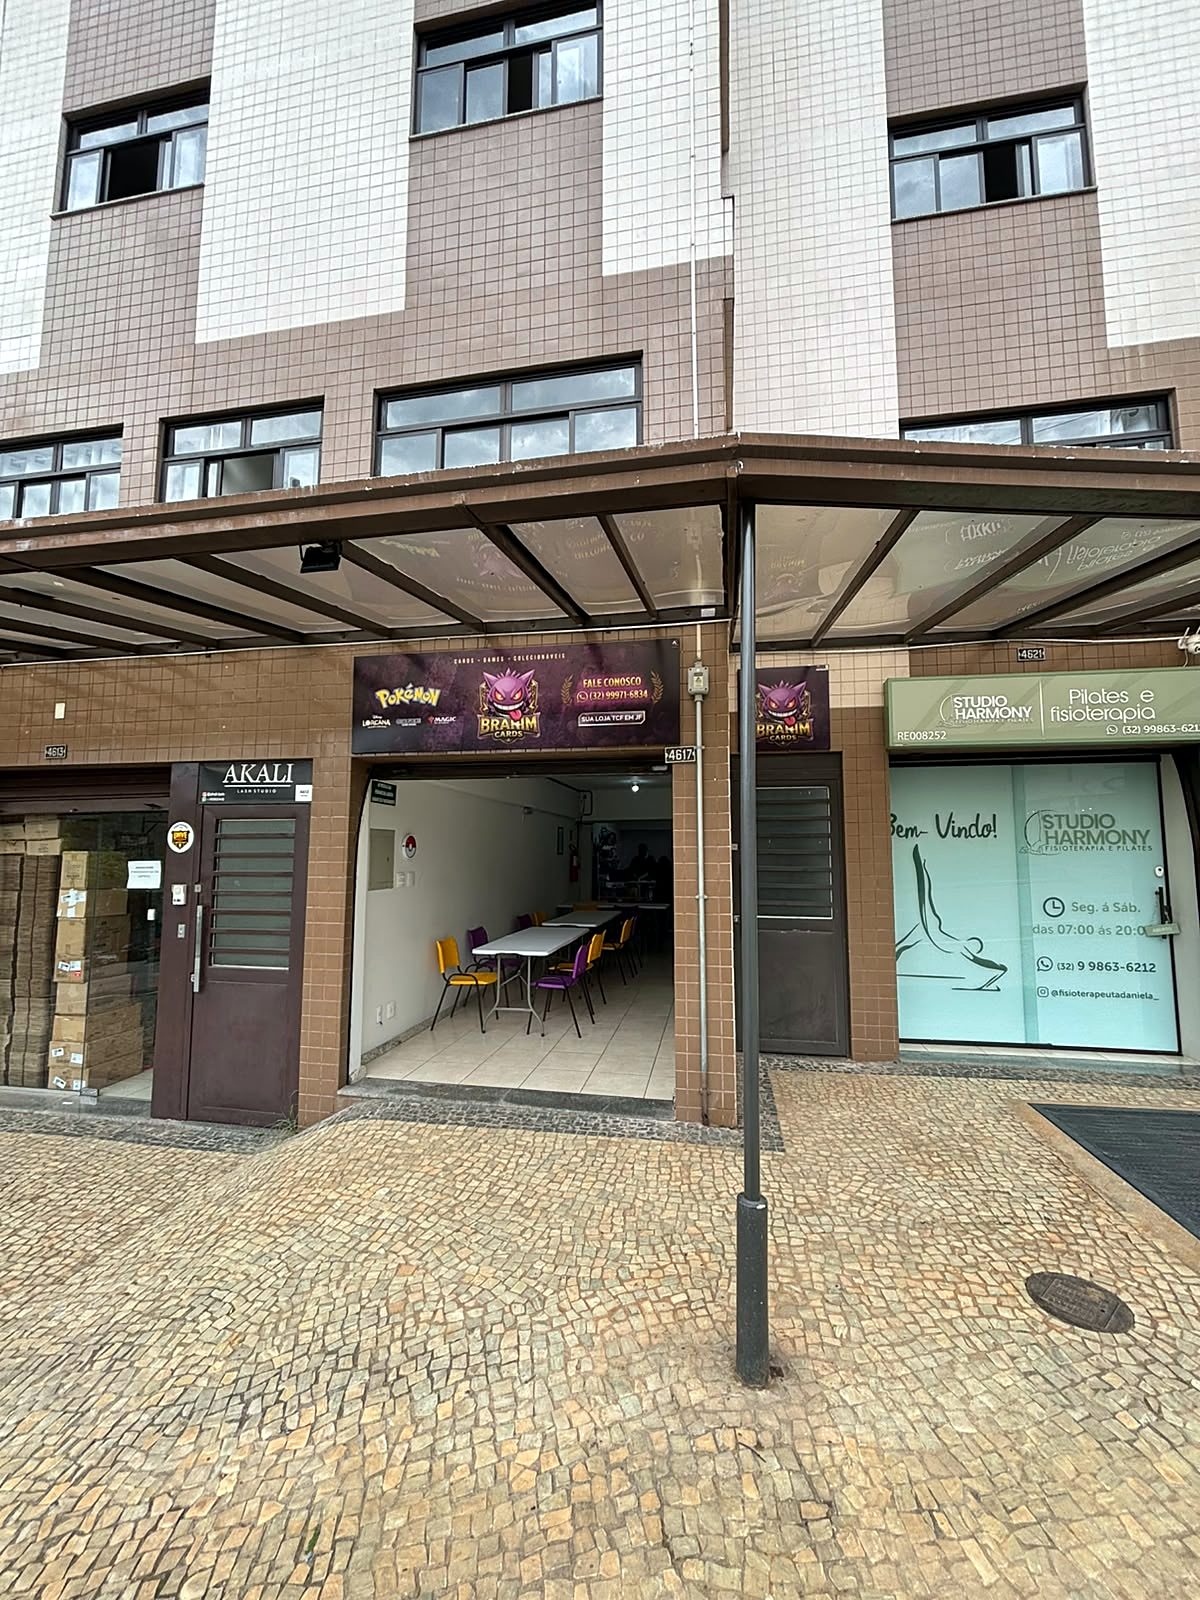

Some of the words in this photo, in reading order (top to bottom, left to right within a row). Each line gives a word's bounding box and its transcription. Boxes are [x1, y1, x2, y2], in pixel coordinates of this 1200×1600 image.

[1021, 649, 1042, 659] 4621
[583, 678, 602, 688] FALE
[603, 676, 642, 687] CONOSCO
[590, 692, 604, 702] (32)
[606, 689, 649, 700] 99971-6834
[953, 695, 1008, 709] STUDIO
[1069, 689, 1130, 706] Pilates
[1140, 690, 1155, 704] e
[955, 706, 1032, 720] HARMONY
[1050, 704, 1156, 724] fisioterapia
[494, 730, 523, 738] CARDS
[897, 730, 947, 741] RE008252
[1122, 725, 1141, 735] (32)
[1143, 724, 1200, 734] 99863-621
[668, 749, 693, 761] 4617
[222, 763, 295, 783] AKALI
[935, 810, 998, 839] Vindo!
[1042, 813, 1116, 829] STUDIO
[1044, 829, 1152, 846] HARMONY
[1116, 844, 1153, 852] PILATES
[1071, 902, 1099, 915] Seg.
[1102, 901, 1110, 913] á
[1113, 901, 1141, 913] Sáb.
[1032, 923, 1054, 935] das
[1057, 924, 1095, 935] 07:00
[1098, 923, 1112, 936] ás
[1115, 925, 1146, 936] 20:0
[1057, 962, 1075, 972] (32)
[1077, 961, 1085, 971] 9
[1088, 961, 1157, 973] 9863-6212
[1051, 988, 1159, 1001] @fisioterapeutadaniela_
